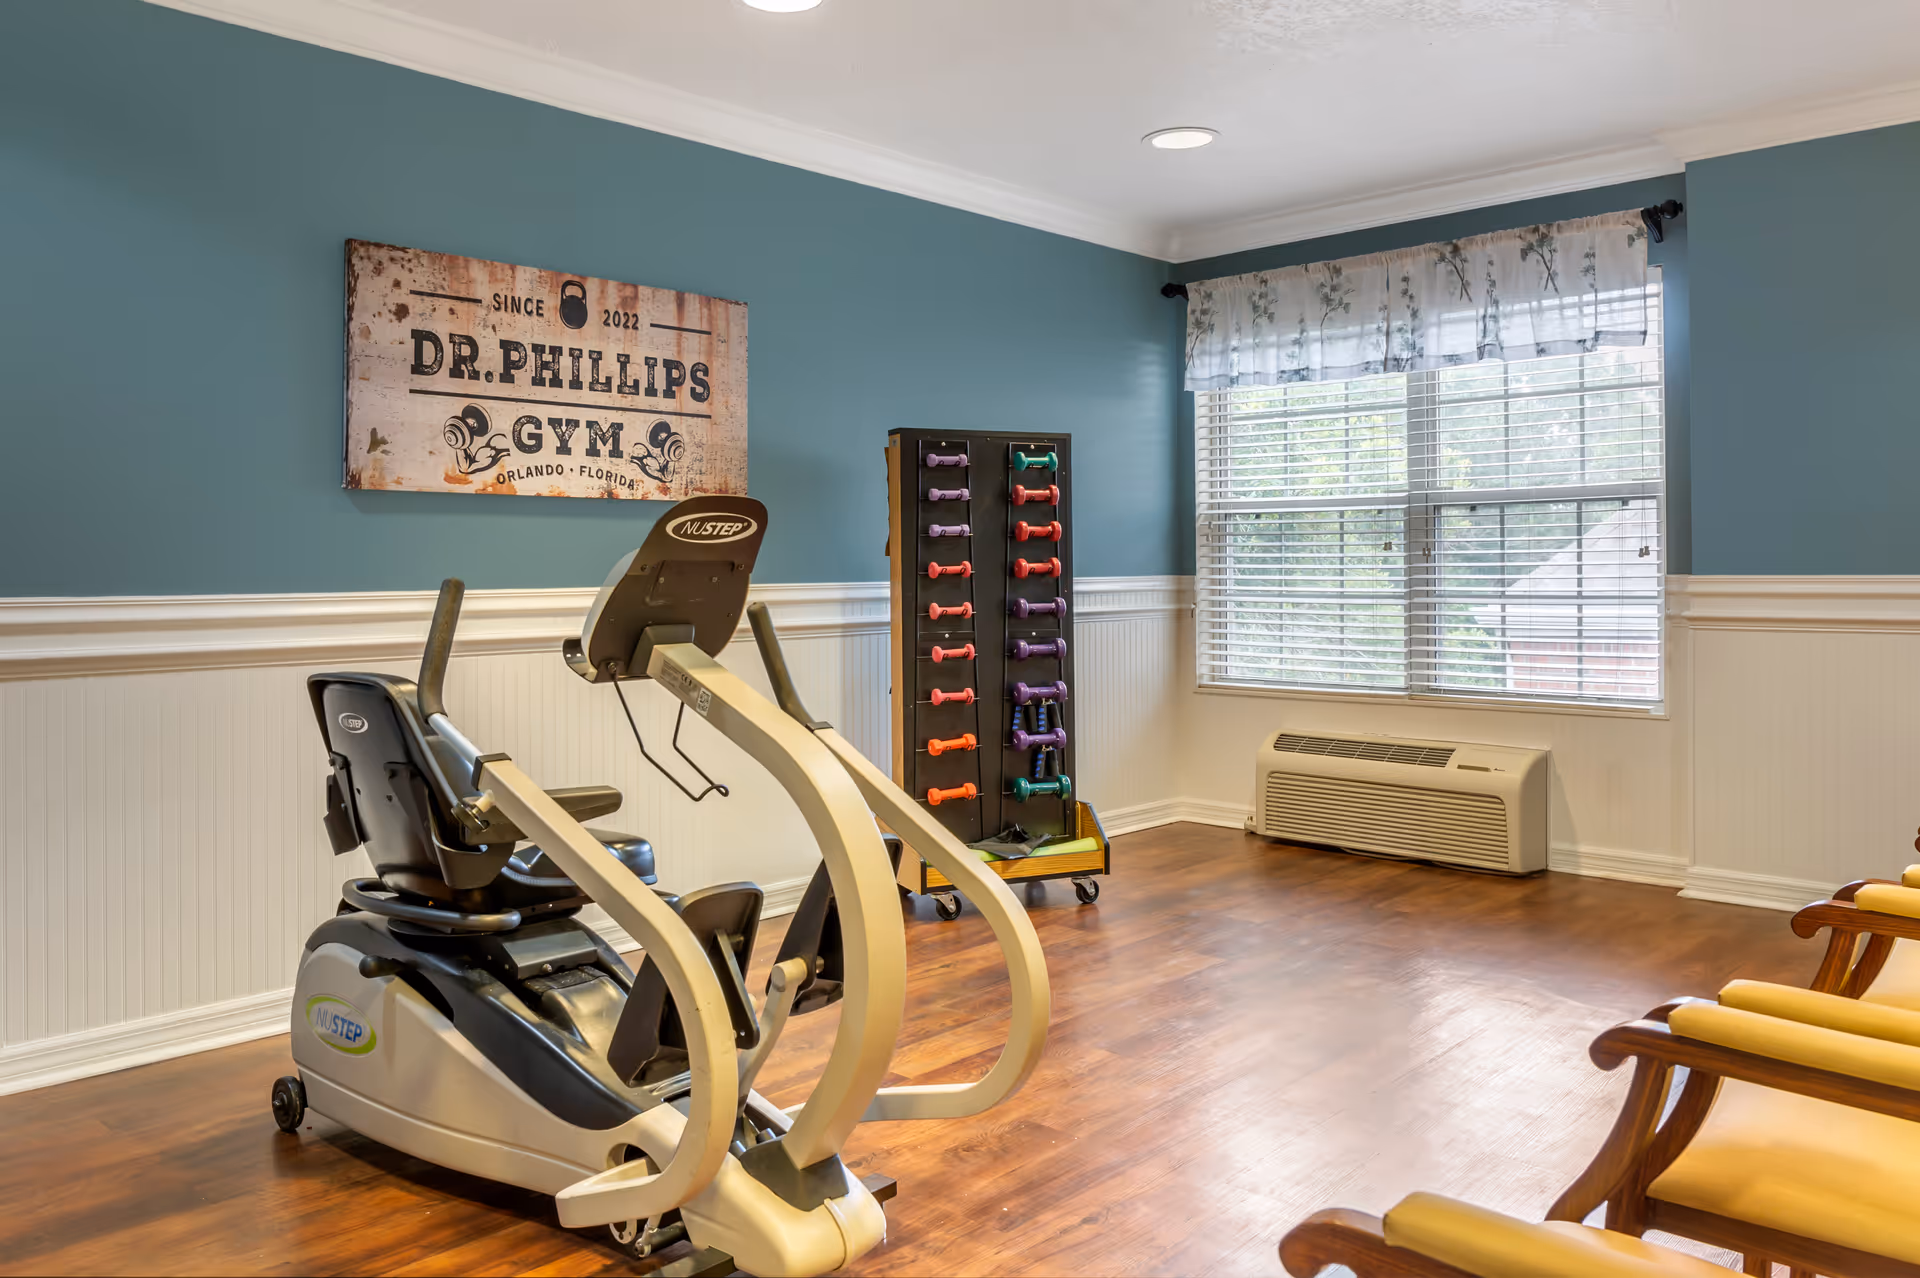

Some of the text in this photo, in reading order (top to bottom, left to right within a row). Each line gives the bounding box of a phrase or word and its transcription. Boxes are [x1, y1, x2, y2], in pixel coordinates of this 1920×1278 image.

[493, 292, 640, 330] SINCE 2022
[512, 415, 624, 459] GYM
[496, 464, 635, 490] ORLANDO FLORIDA
[316, 1007, 362, 1043] NUSTEP
